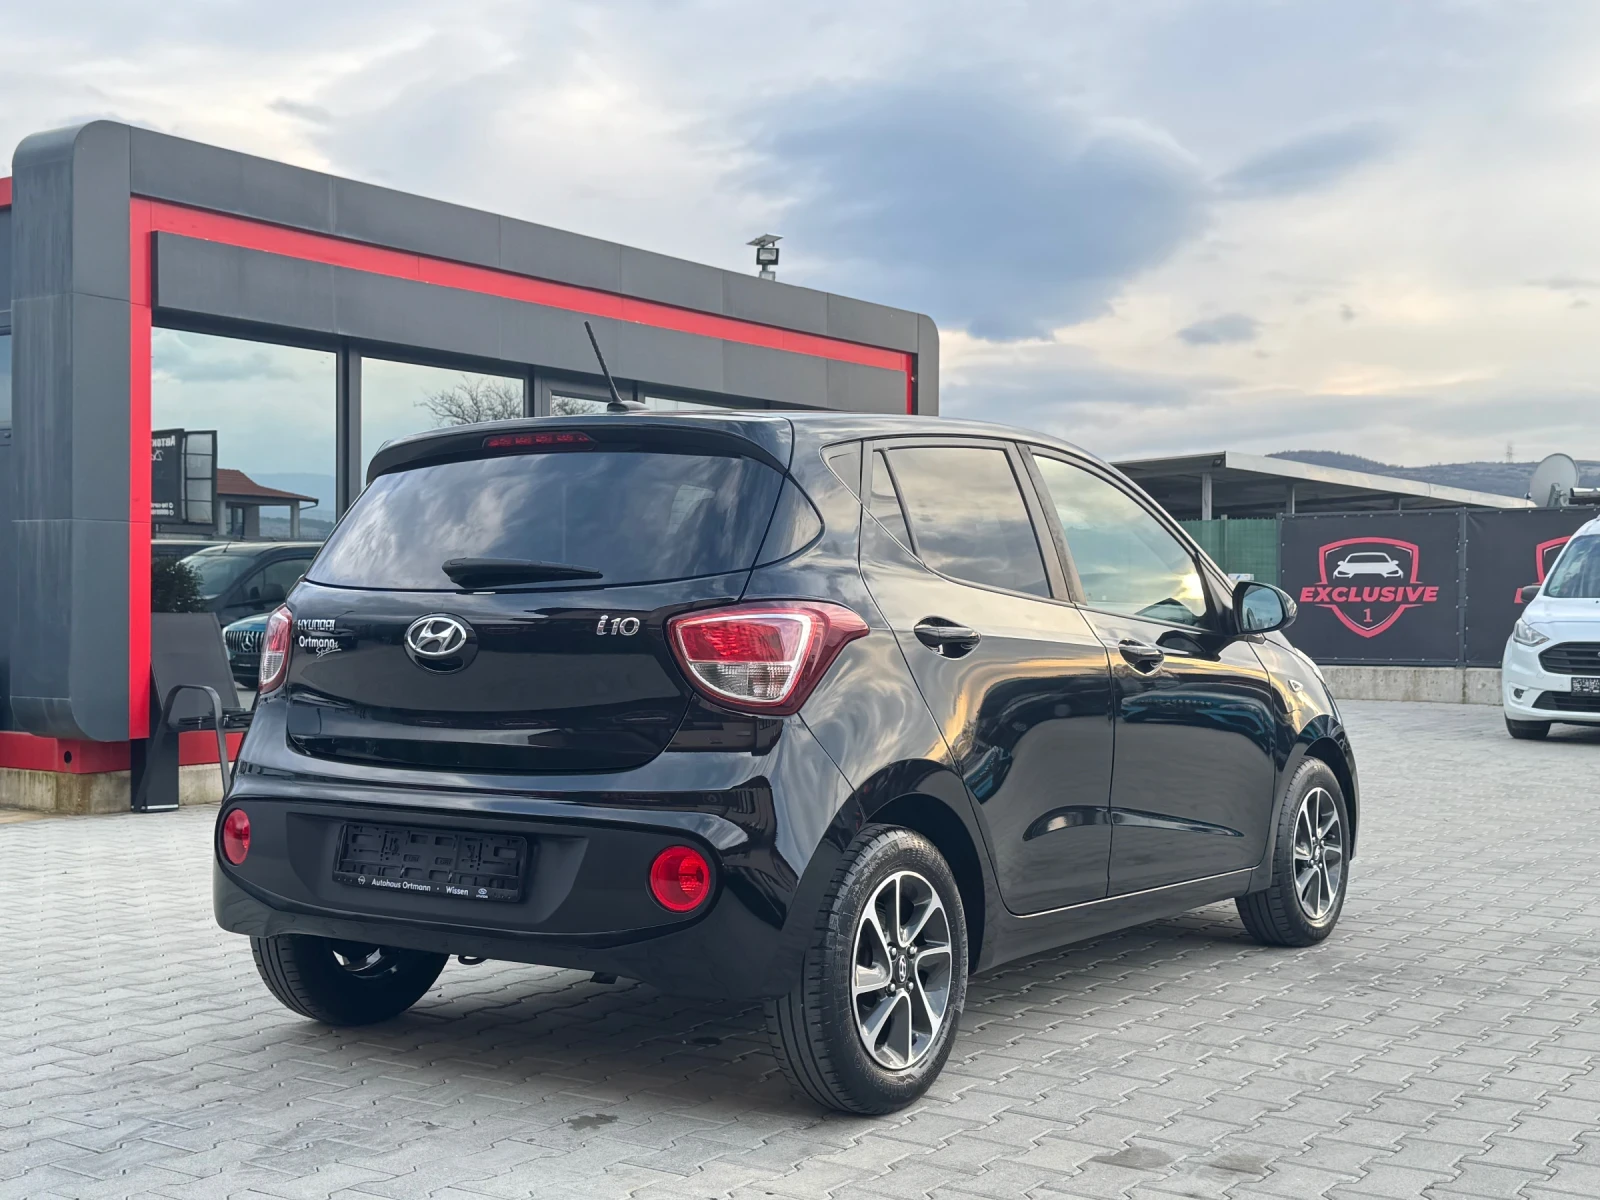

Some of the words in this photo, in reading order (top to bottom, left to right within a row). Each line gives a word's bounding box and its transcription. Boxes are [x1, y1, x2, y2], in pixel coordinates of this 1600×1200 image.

[1299, 586, 1440, 602] EXCLUSIVE
[1363, 608, 1373, 622] 1
[297, 619, 336, 630] HYUNDAI
[596, 614, 640, 636] i10
[298, 635, 335, 648] Ortmann
[371, 878, 401, 889] Autohaus
[402, 881, 431, 892] Ortmann
[445, 885, 469, 896] Wissen
